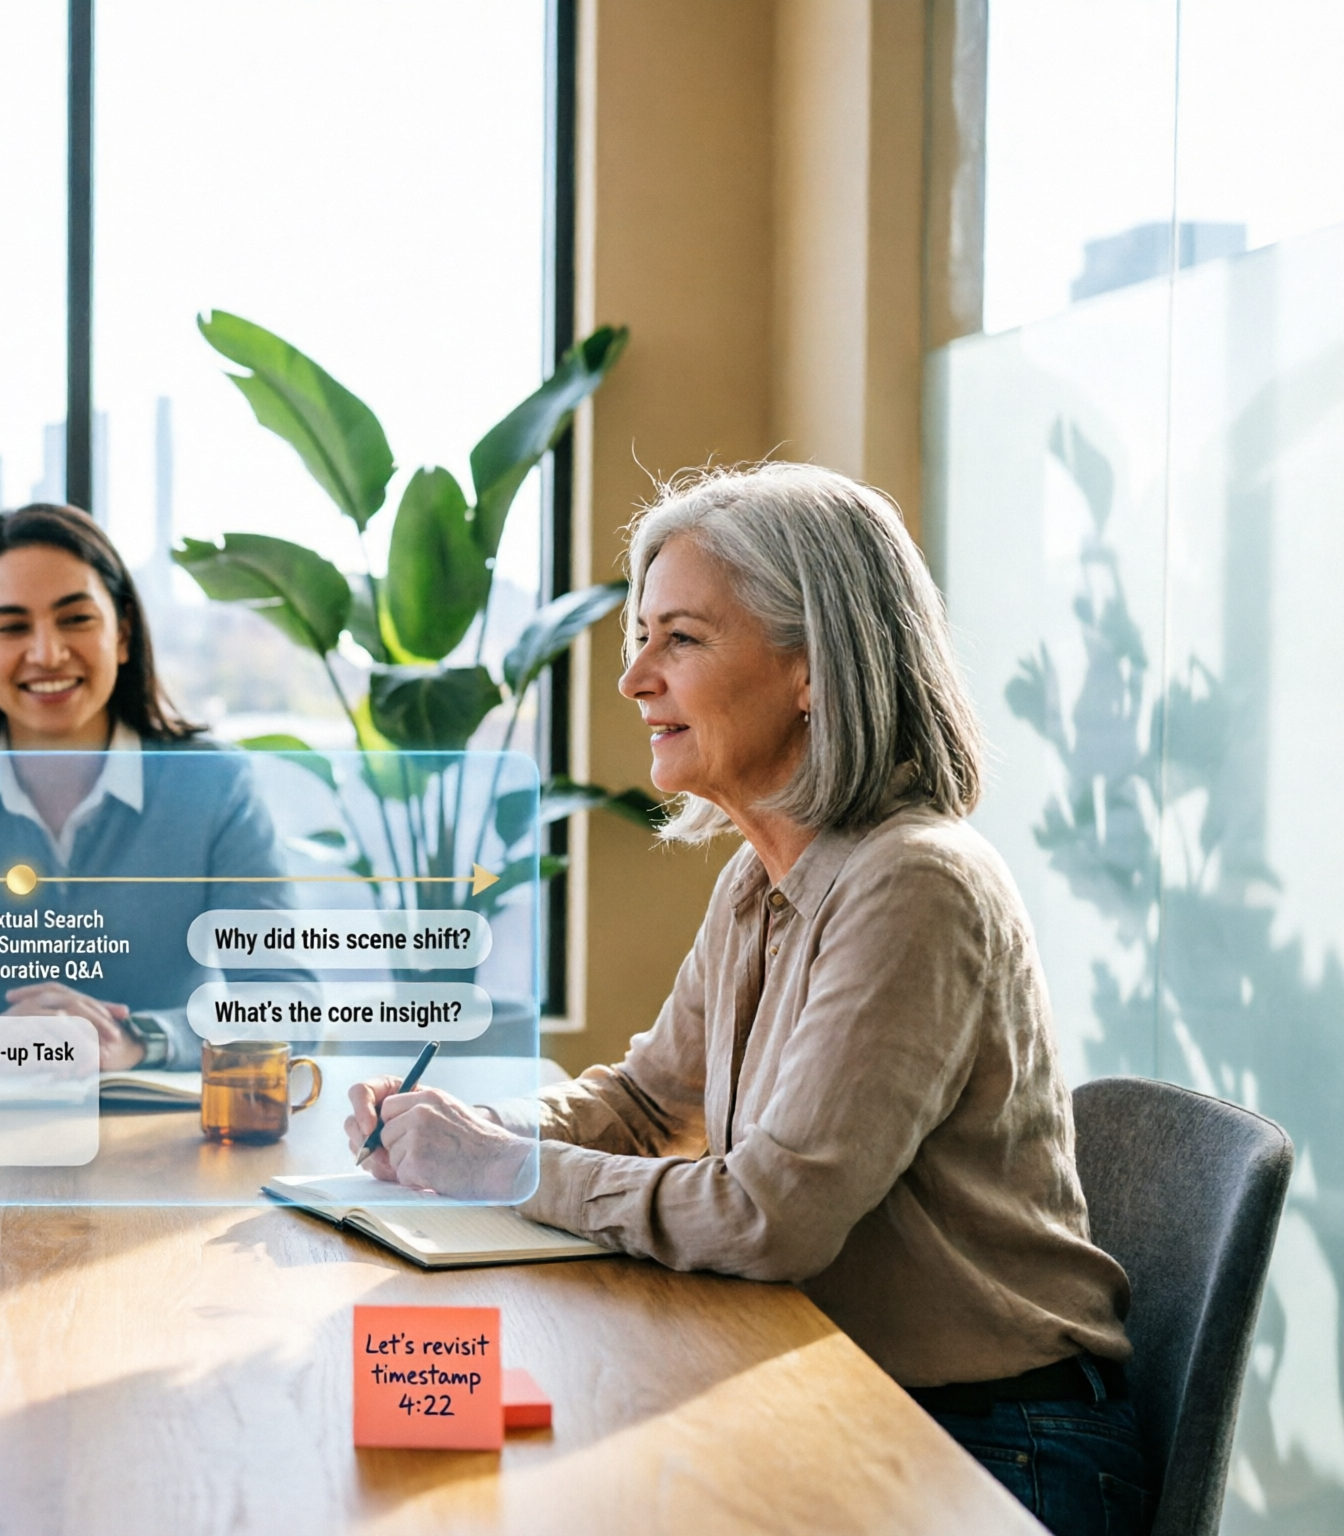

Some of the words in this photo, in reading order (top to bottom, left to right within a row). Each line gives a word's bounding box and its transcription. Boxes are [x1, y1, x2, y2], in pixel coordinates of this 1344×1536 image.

[365, 1332, 415, 1355] Let's
[422, 1334, 490, 1357] revisit
[371, 1363, 482, 1394] timestamp
[398, 1394, 455, 1417] 4:22
